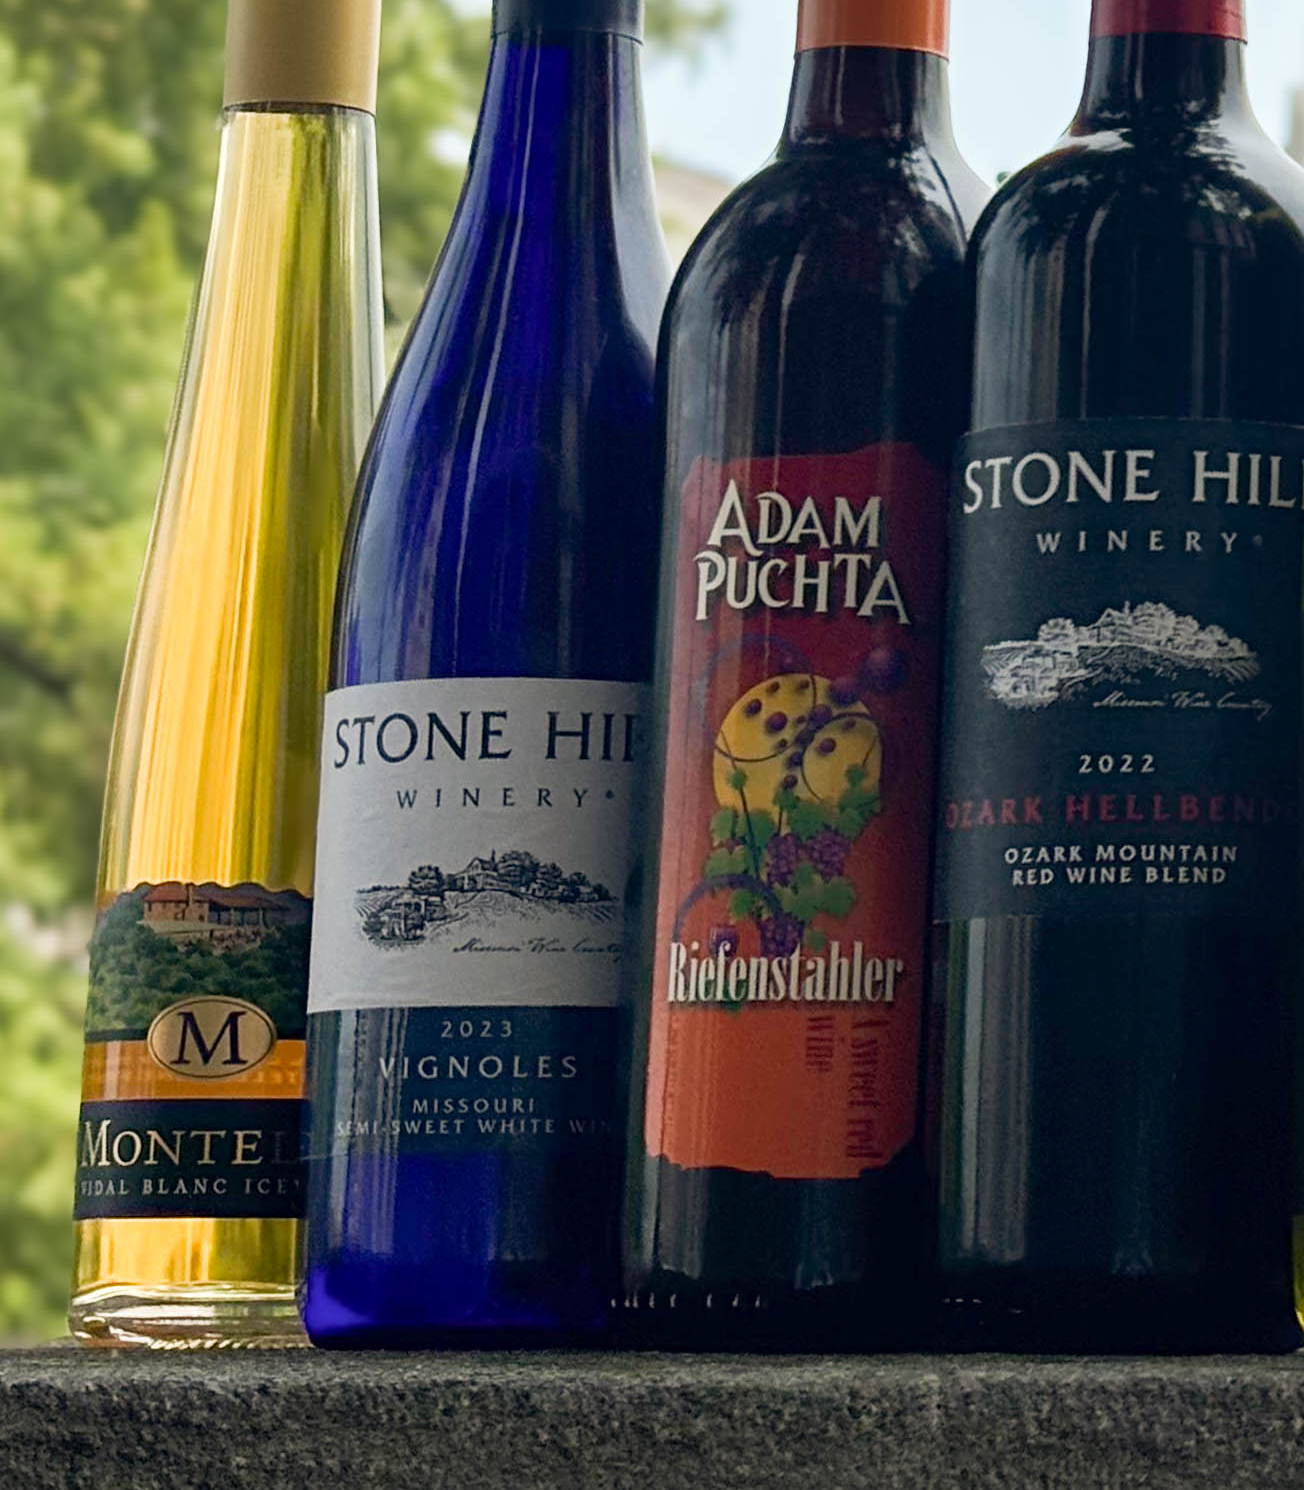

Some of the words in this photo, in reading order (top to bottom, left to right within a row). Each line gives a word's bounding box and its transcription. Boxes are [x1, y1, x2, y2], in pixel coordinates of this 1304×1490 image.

[963, 450, 1161, 514] STONE
[707, 478, 882, 557] ADAM
[692, 550, 912, 625] PUCHTA
[334, 710, 513, 769] STONE
[1078, 754, 1156, 774] 2022
[945, 797, 1043, 832] OZARK
[1004, 845, 1084, 865] OZARK
[1095, 844, 1239, 862] MOUNTAIN
[1012, 868, 1055, 886] RED
[1067, 866, 1132, 885] WINE
[1145, 866, 1227, 884] BLEND
[667, 940, 904, 1002] Riefenstahler
[172, 1011, 247, 1066] M
[441, 1020, 514, 1038] 2023
[379, 1056, 578, 1080] VIGNOLES
[412, 1098, 536, 1114] MISSOURI
[477, 1118, 556, 1136] WHITE
[81, 1179, 130, 1196] VIDAL
[142, 1177, 228, 1195] BLANC
